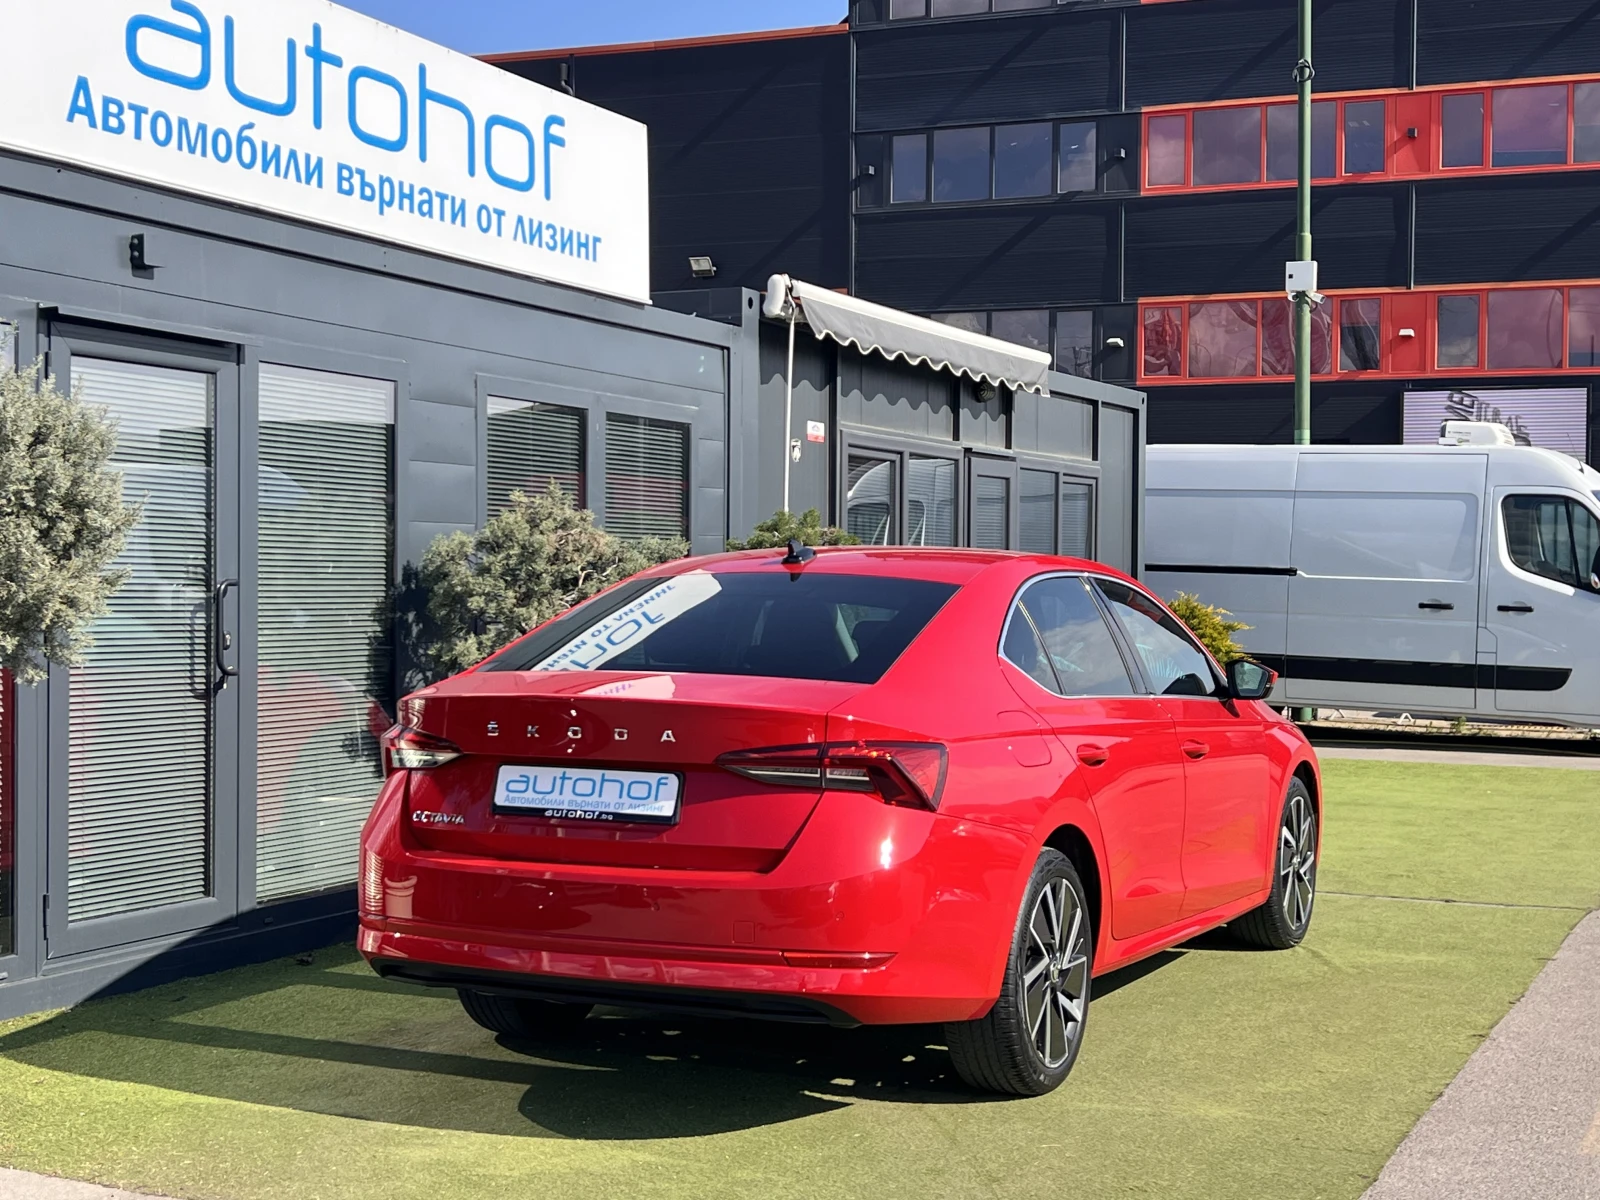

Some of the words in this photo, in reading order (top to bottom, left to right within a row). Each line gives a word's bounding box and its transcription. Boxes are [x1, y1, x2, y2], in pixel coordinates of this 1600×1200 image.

[125, 0, 566, 201] autohof
[66, 75, 323, 189] Автомобили
[336, 162, 466, 229] върнати
[476, 204, 506, 237] от
[514, 215, 602, 262] лизинг
[505, 770, 669, 801] autohof
[412, 810, 465, 824] OCTAVIA
[503, 793, 565, 806] Автомобили
[567, 800, 612, 812] върнати
[614, 802, 625, 811] от
[628, 804, 666, 813] лизинг
